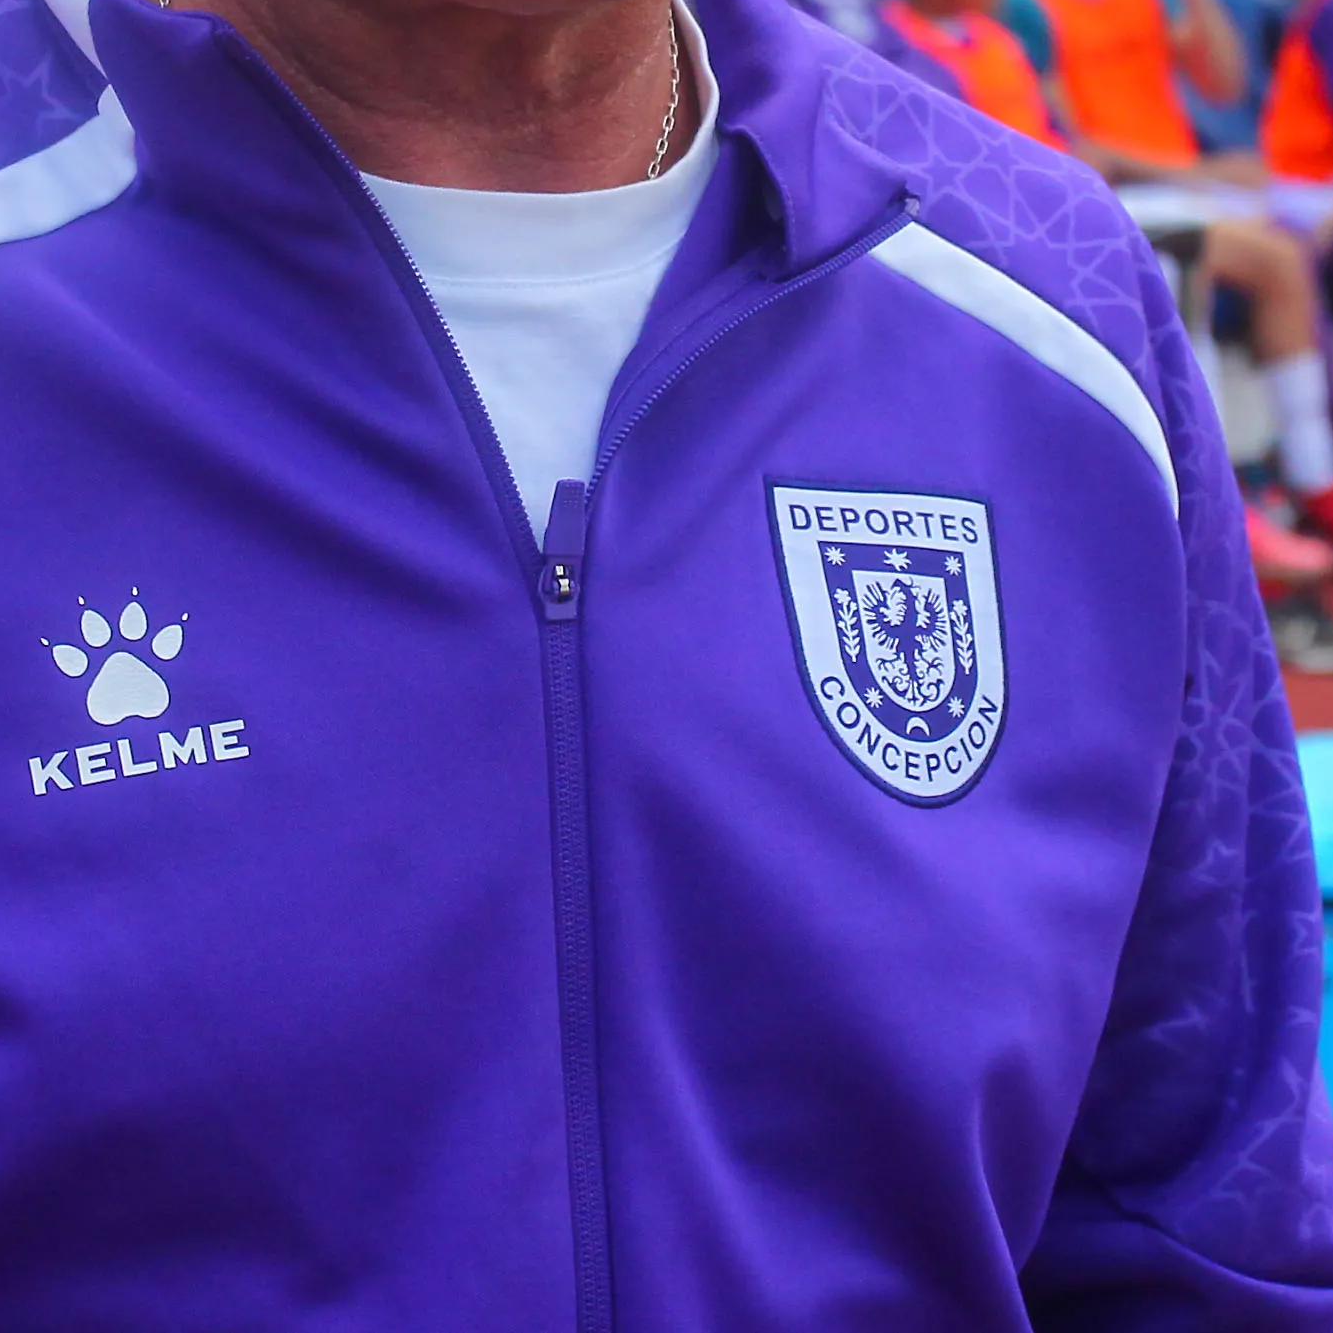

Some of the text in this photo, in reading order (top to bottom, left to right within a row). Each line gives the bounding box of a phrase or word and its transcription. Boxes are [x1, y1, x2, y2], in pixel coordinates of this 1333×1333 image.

[788, 504, 979, 545] DEPORTES
[28, 719, 250, 796] KELME
[819, 675, 1000, 782] CONCEPCION
